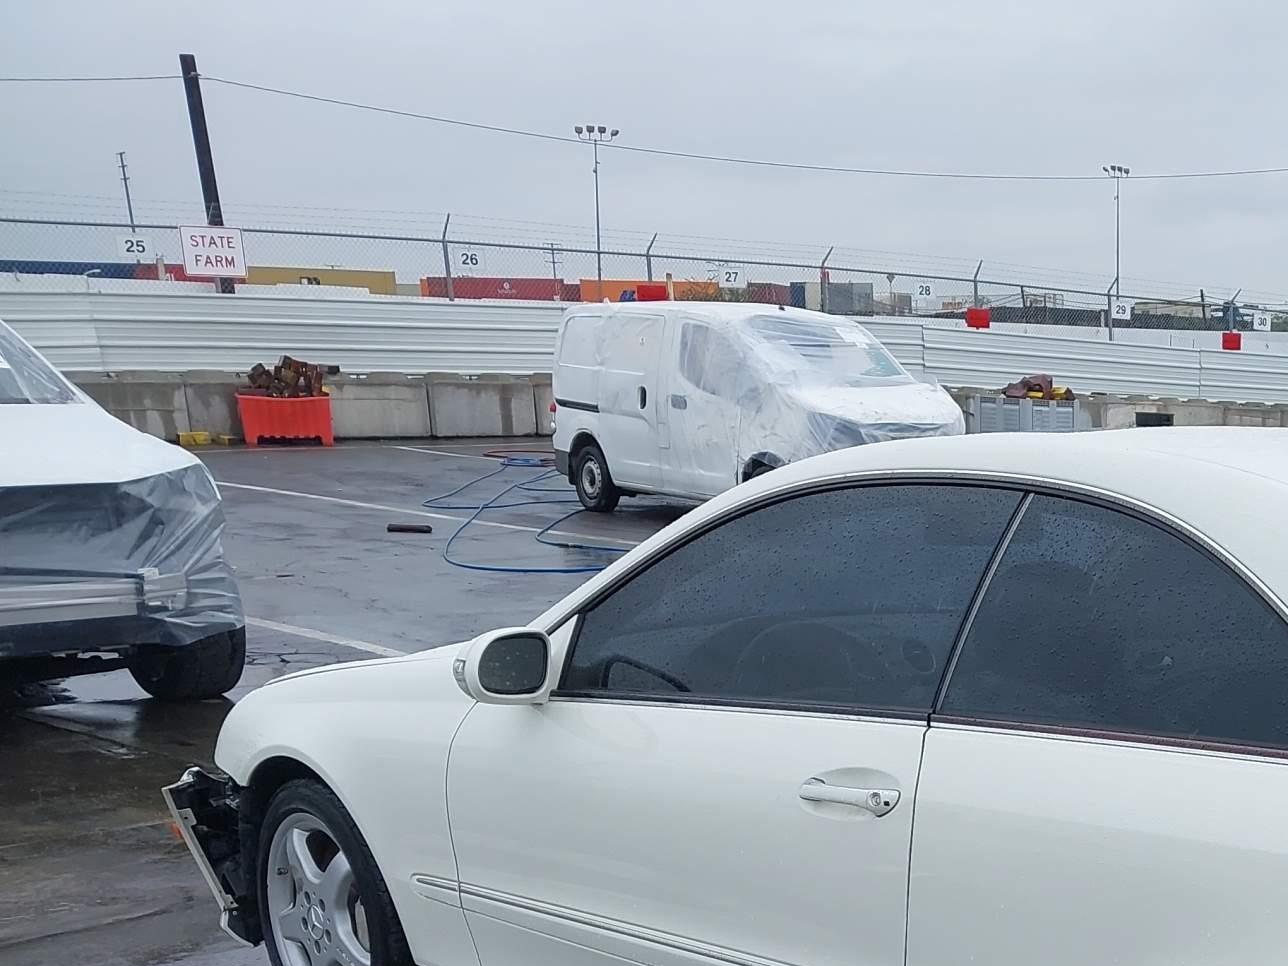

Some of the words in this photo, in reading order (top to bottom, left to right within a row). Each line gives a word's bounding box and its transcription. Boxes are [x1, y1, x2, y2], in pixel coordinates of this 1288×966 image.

[124, 239, 146, 254] 25
[190, 234, 236, 249] STATE
[194, 254, 236, 269] FARM
[461, 252, 479, 266] 26
[724, 271, 739, 283] 27
[918, 285, 931, 297] 28
[1115, 304, 1127, 315] 29
[1257, 317, 1267, 327] 30
